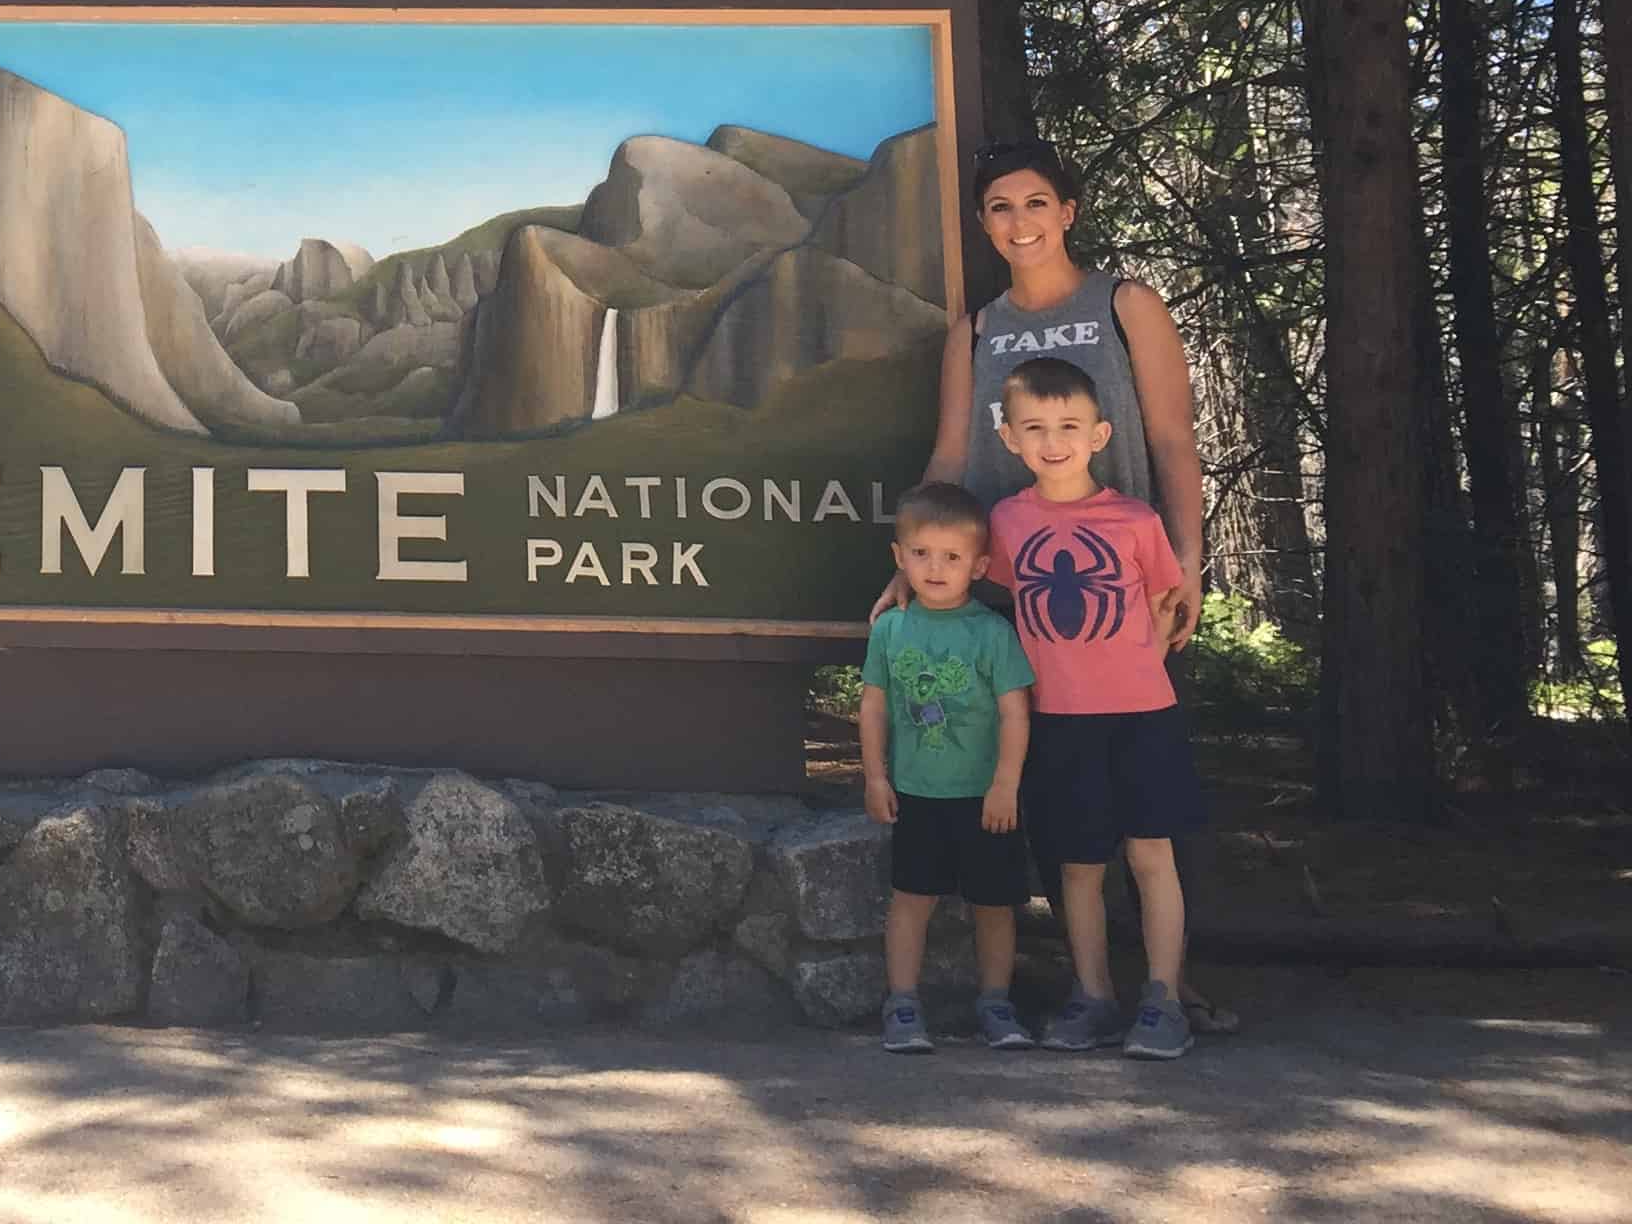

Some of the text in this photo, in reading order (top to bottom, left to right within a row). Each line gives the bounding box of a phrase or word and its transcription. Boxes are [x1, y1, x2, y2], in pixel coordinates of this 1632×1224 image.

[989, 320, 1101, 356] TAKE
[526, 474, 897, 525] NATIONAL
[525, 537, 711, 587] PARK
